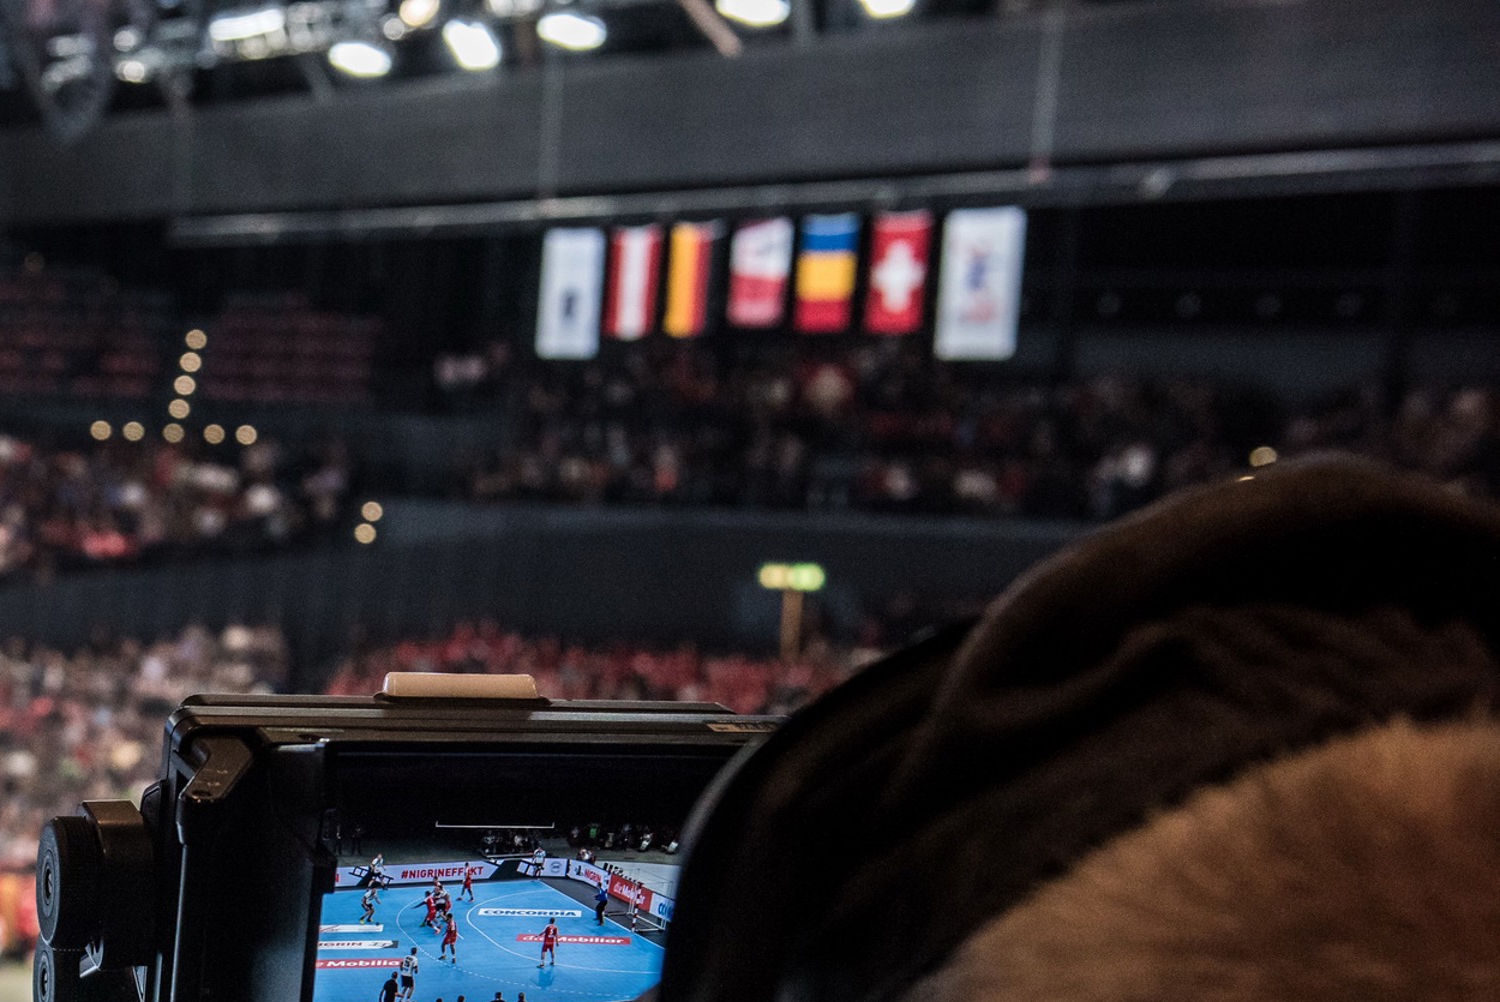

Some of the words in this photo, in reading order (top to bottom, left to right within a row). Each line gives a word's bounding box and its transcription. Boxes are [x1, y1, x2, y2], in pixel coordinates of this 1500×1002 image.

[401, 866, 484, 879] #NIGRINEFFKT
[483, 909, 577, 917] CONCORDIA
[326, 959, 401, 967] Mobilia
